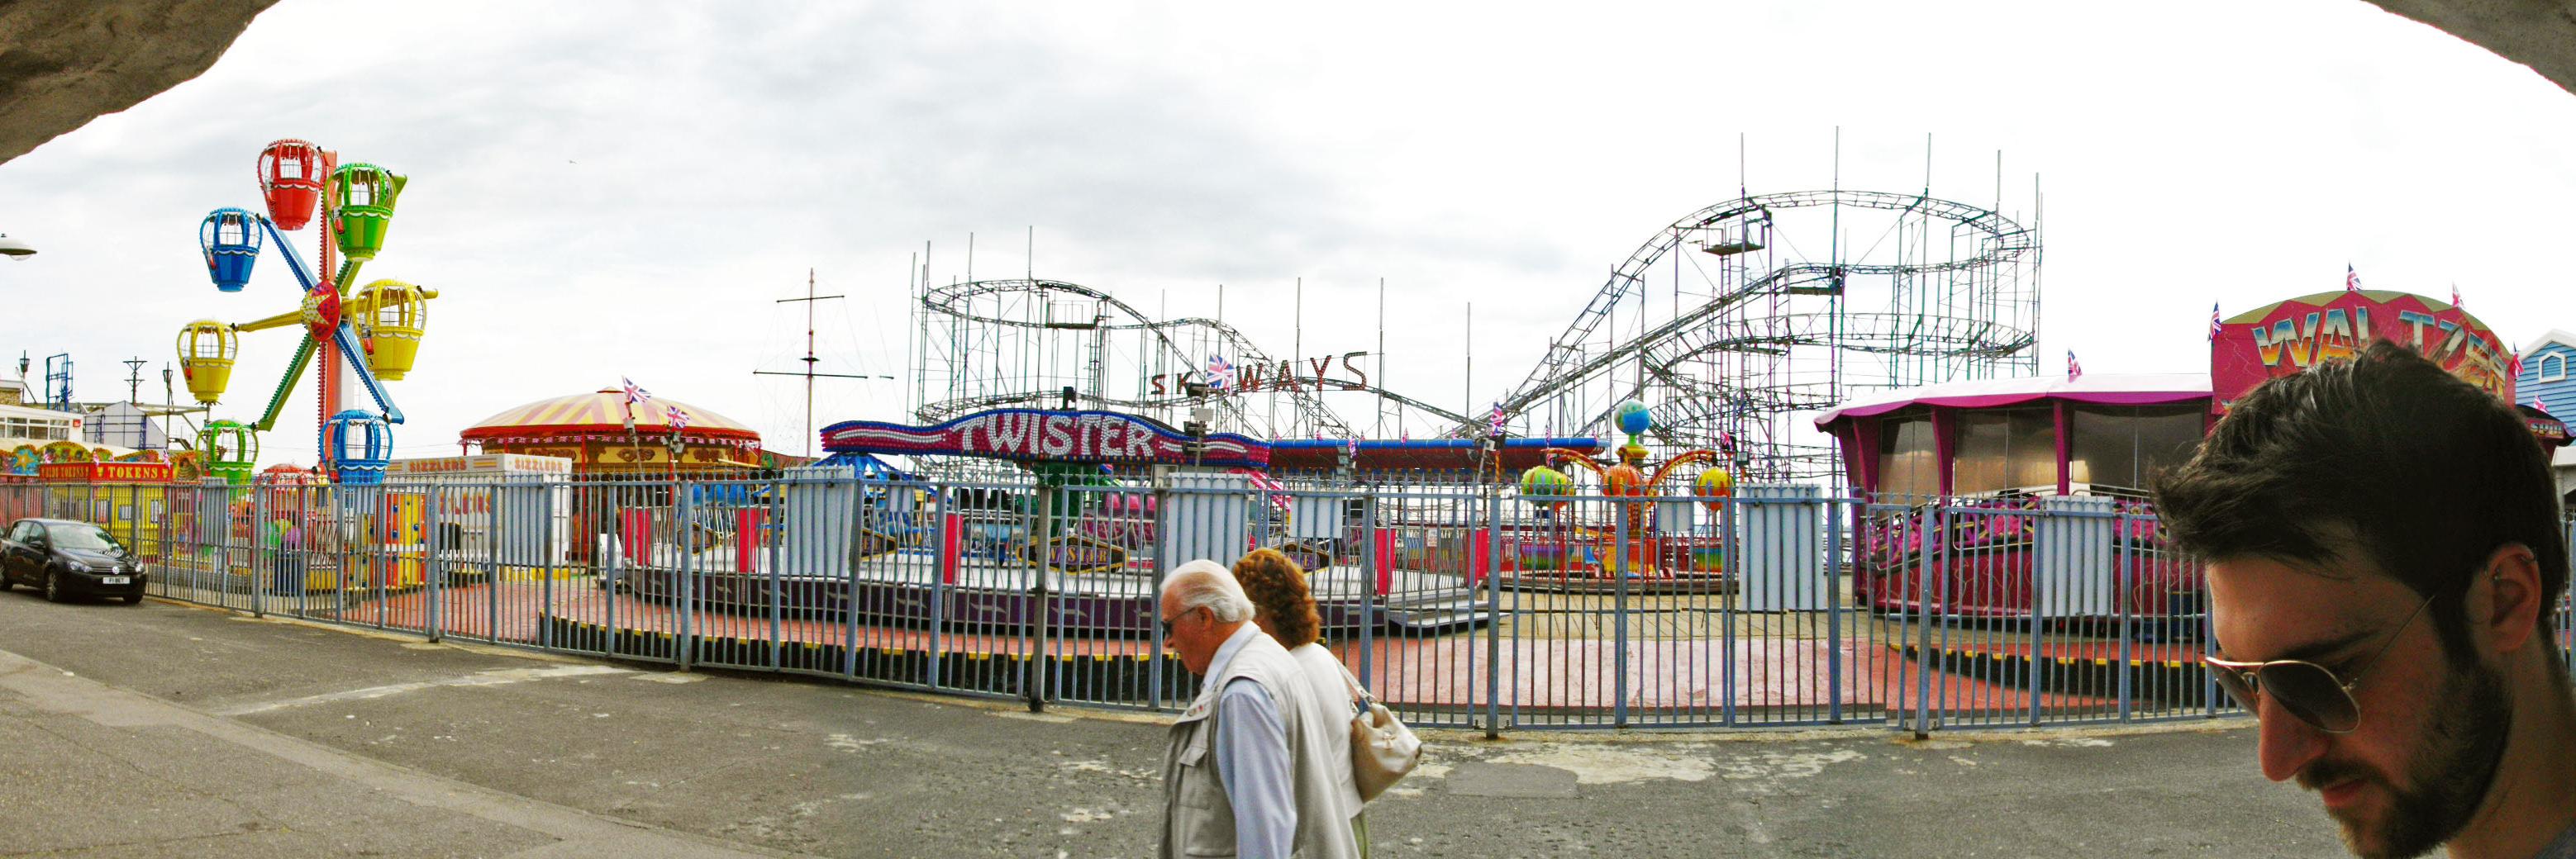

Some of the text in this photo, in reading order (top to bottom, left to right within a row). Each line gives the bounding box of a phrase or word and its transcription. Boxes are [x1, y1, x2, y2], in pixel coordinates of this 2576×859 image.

[367, 358, 374, 368] 3
[1151, 351, 1368, 396] SKWAYS
[951, 412, 1155, 457] TWISTER
[409, 458, 467, 472] SIZZLERS
[514, 458, 563, 472] SIZZLERS
[108, 466, 159, 479] TOKENS
[1044, 546, 1109, 564] WSTER
